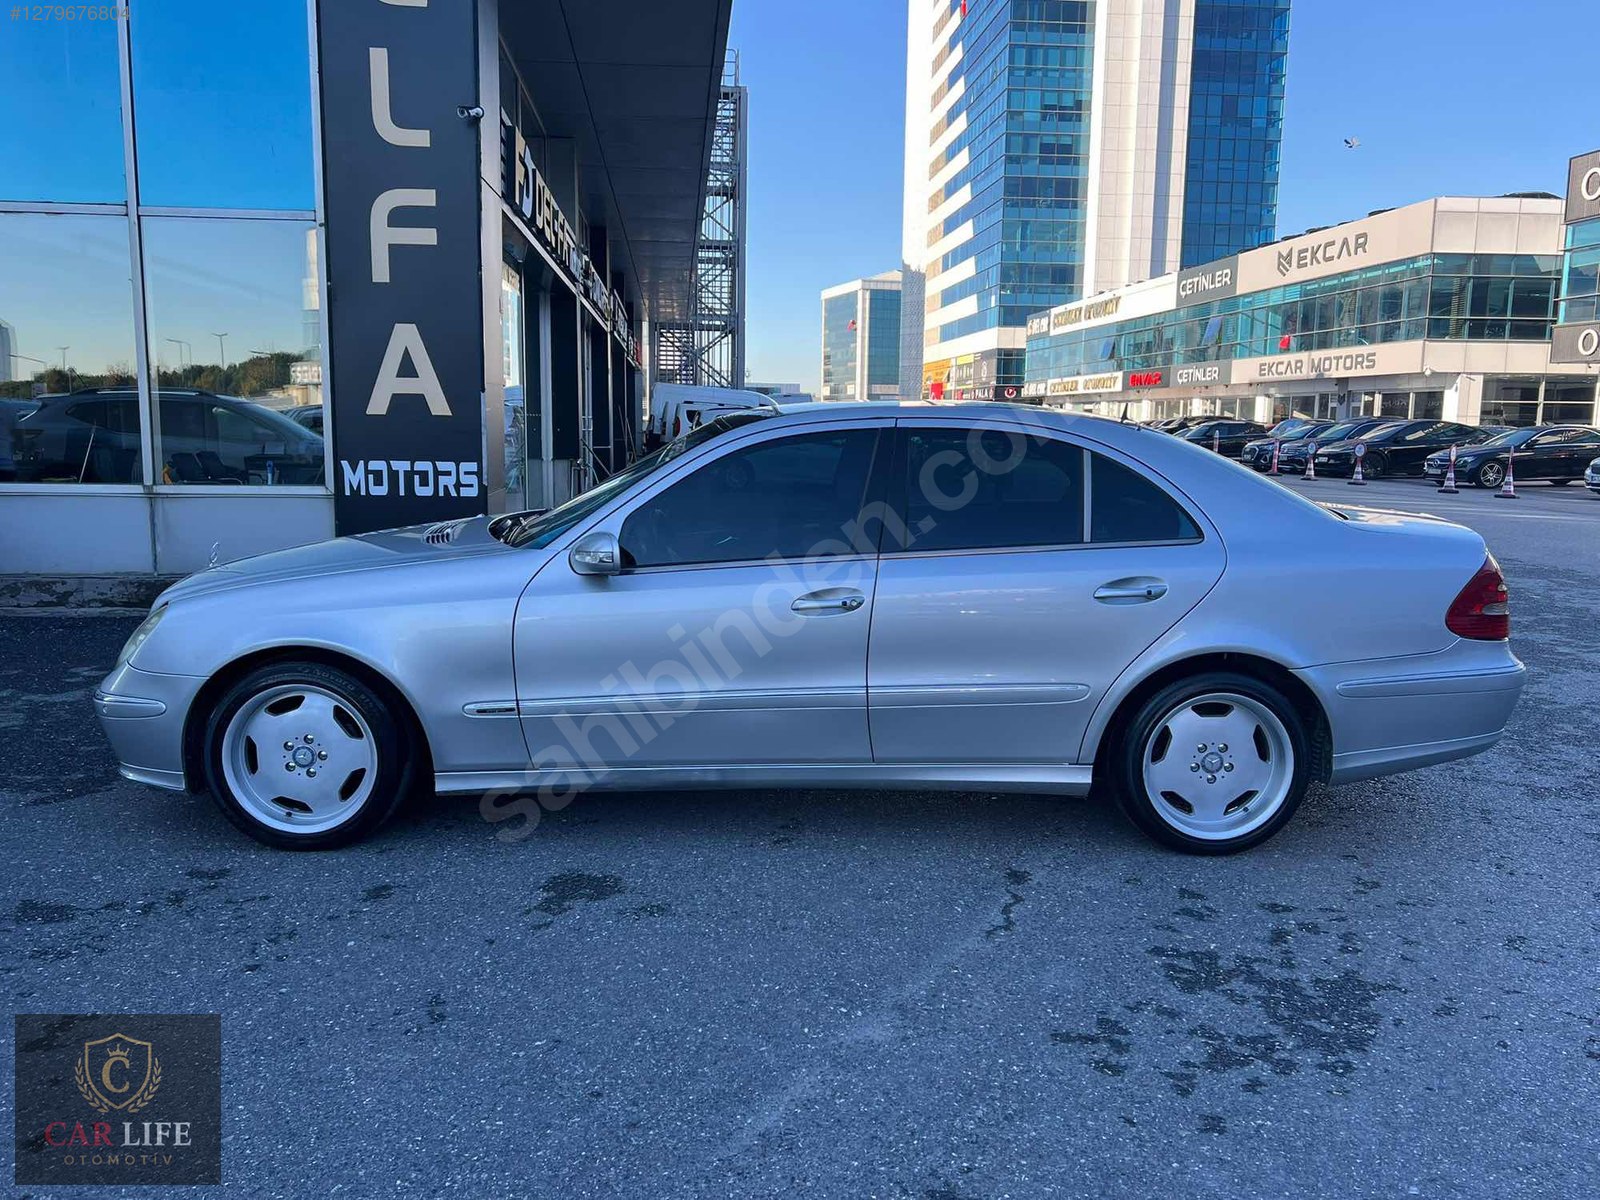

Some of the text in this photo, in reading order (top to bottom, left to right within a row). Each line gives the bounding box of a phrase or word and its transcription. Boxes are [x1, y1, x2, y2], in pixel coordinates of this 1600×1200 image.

[1296, 232, 1369, 269] EKCAR
[1179, 268, 1232, 299] ÇETİNLER
[1176, 366, 1220, 385] ÇETİNLER
[1258, 352, 1377, 377] EKCAR MOTORS
[340, 460, 479, 497] MOTORS
